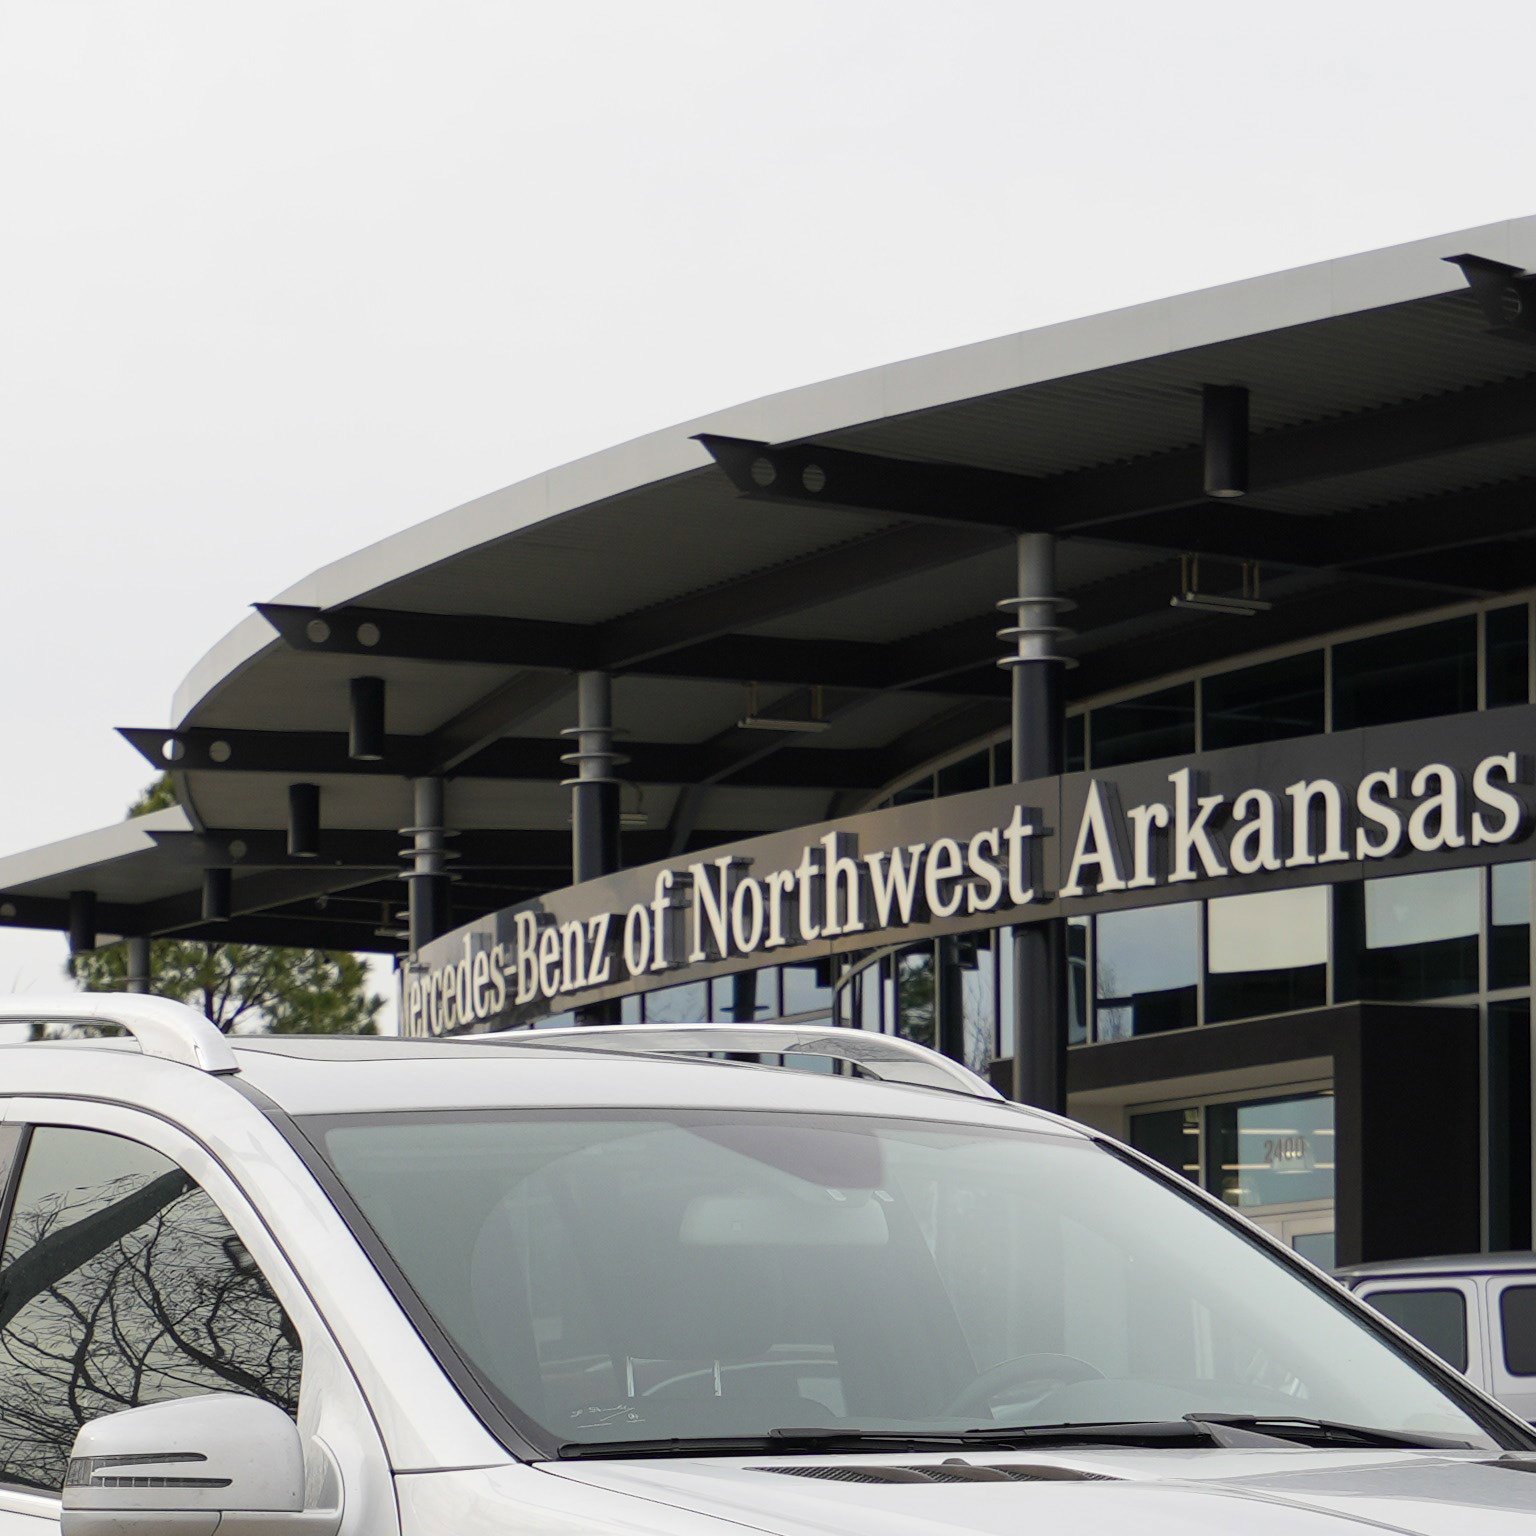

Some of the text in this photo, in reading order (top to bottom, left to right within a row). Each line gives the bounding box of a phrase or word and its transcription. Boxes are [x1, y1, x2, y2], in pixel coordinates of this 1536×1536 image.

[623, 869, 673, 976] of
[688, 804, 1034, 963] Northwest
[1059, 751, 1524, 898] Arkansas
